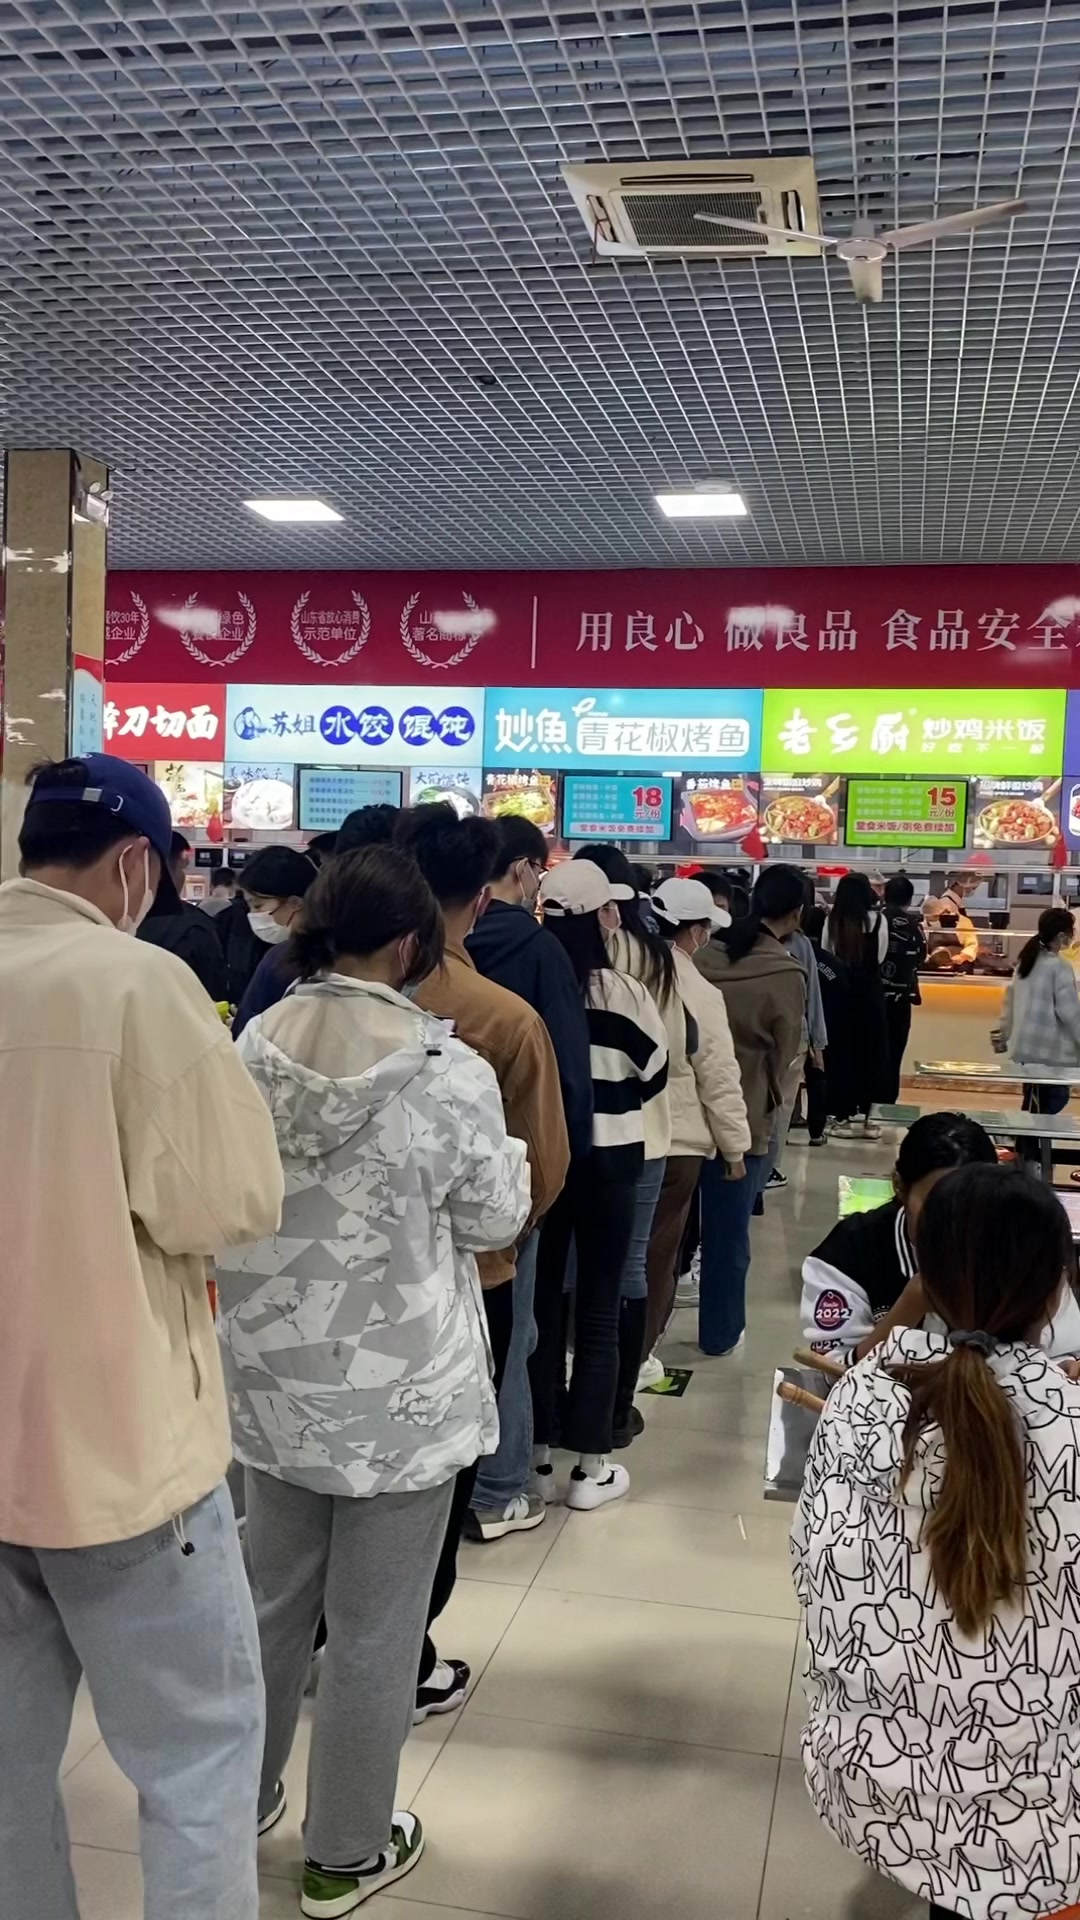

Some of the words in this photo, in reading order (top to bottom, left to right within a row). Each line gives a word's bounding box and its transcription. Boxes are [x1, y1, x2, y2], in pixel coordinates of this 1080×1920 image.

[192, 627, 244, 641] 企业
[303, 627, 357, 641] 示范单位
[575, 610, 705, 652] 用良心
[724, 609, 859, 652] 做良品
[881, 608, 1080, 652] 食品安全
[269, 711, 318, 738] 苏姐
[325, 711, 393, 740] 水饺
[403, 714, 472, 741] 馄饨
[580, 722, 746, 752] 青花椒烤鱼
[922, 718, 1047, 741] 炒鸡米饭
[632, 785, 664, 808] 18
[927, 786, 957, 807] 15
[929, 807, 955, 818] 元/份
[815, 1309, 850, 1319] 2022
